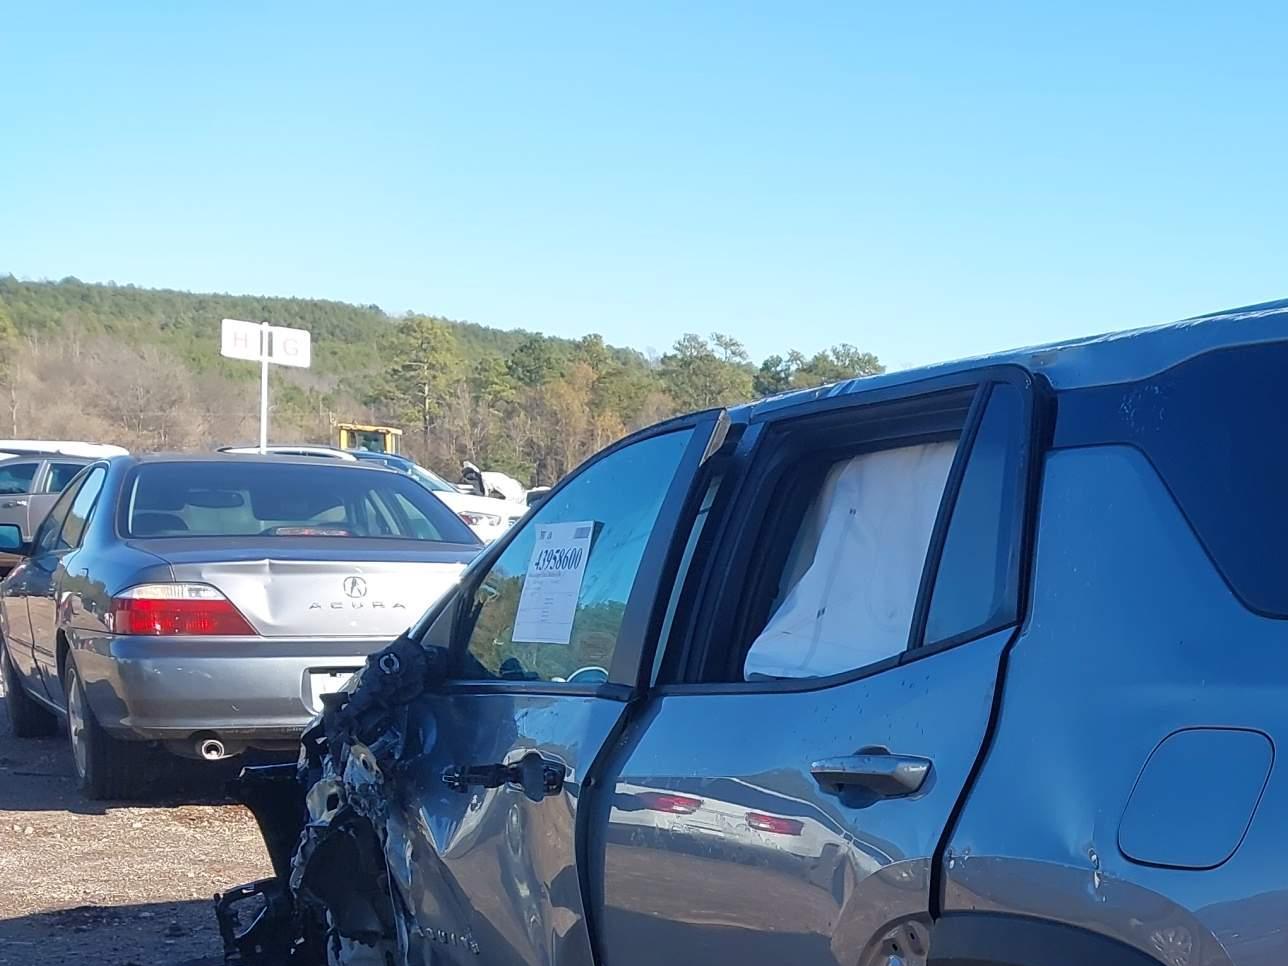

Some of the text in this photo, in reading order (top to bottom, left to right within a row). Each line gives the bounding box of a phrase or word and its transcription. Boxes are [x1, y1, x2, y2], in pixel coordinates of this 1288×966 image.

[233, 331, 248, 348] H
[282, 338, 299, 356] G
[534, 547, 583, 571] 43958600
[308, 601, 407, 609] ACURA
